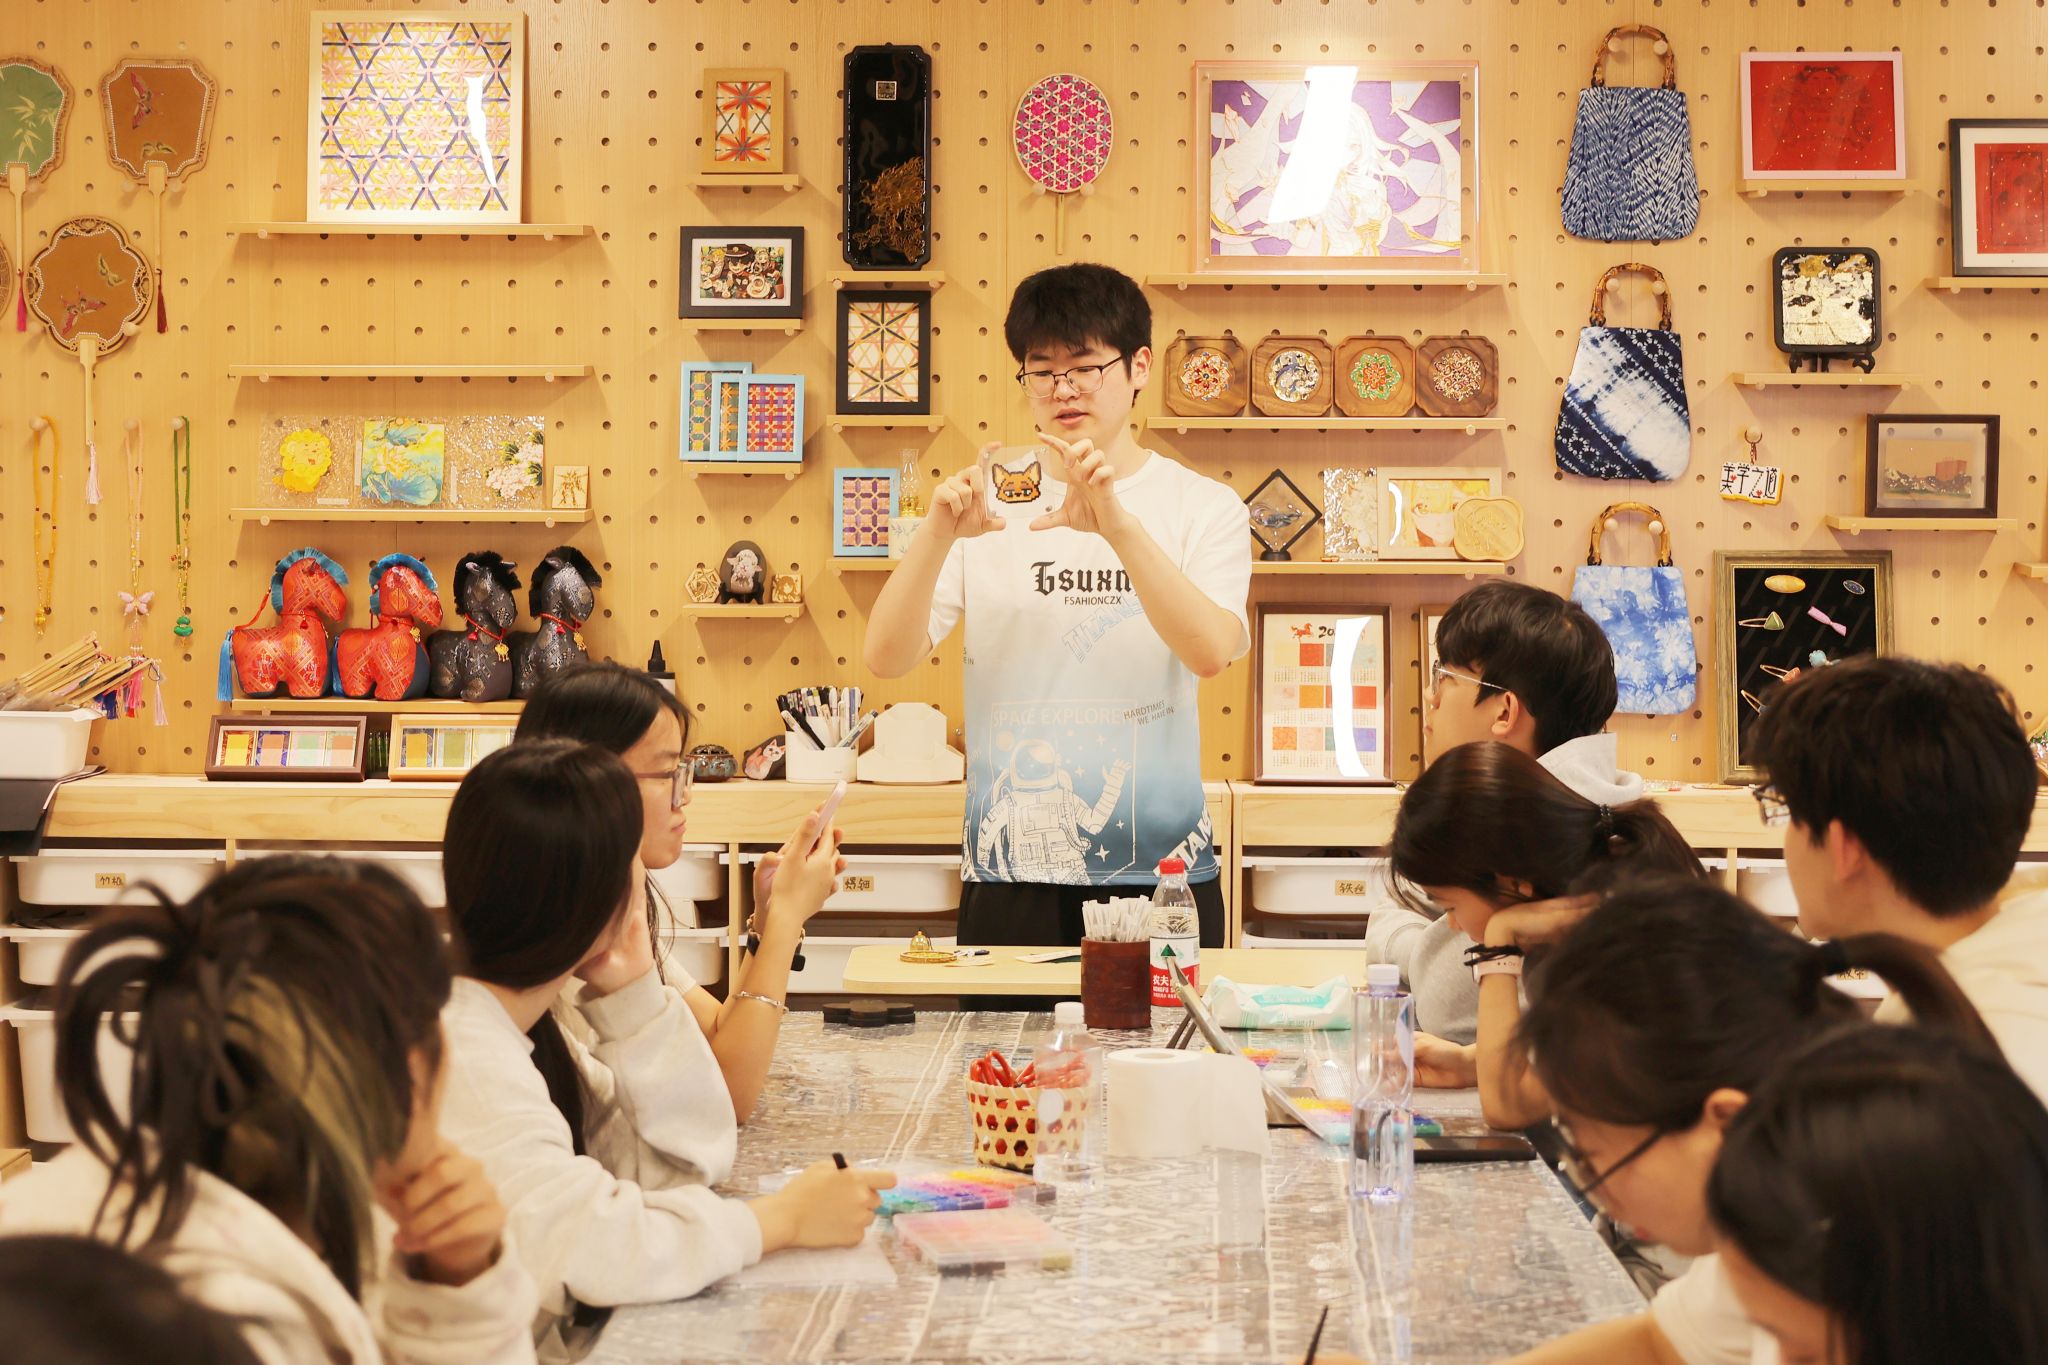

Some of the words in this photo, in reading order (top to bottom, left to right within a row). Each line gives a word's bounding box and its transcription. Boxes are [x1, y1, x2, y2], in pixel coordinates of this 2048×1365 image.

[1720, 463, 1777, 499] 美学之道
[1064, 596, 1122, 606] FSAHIONCZX
[1318, 625, 1336, 638] 20
[991, 707, 1036, 728] SPACE
